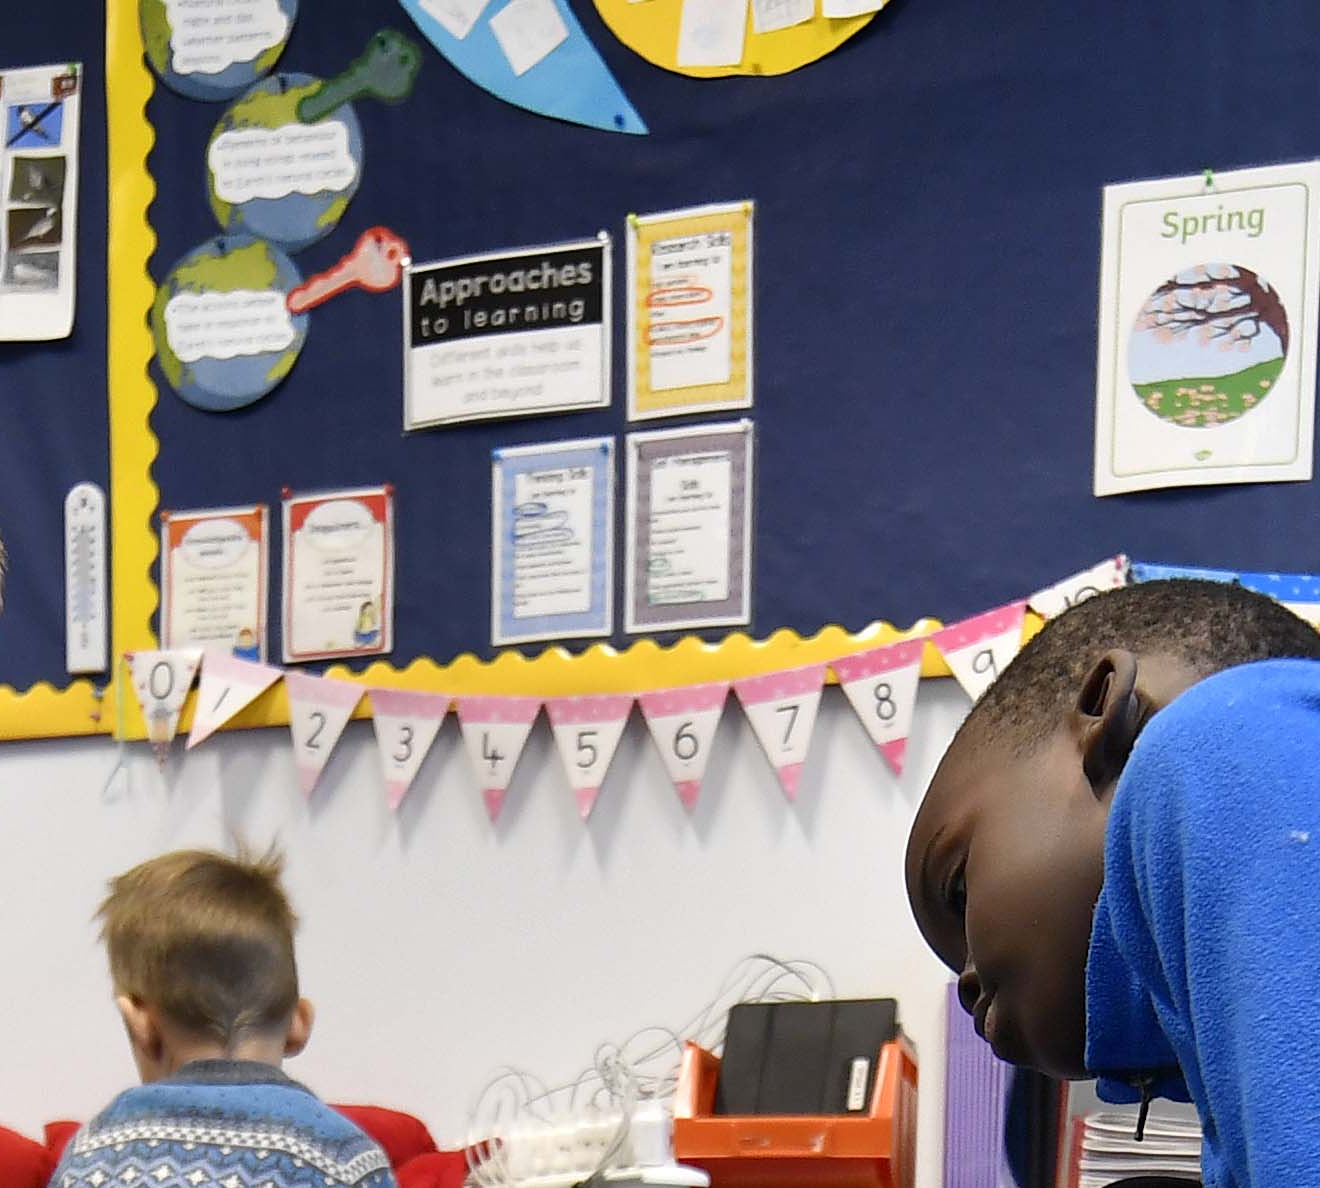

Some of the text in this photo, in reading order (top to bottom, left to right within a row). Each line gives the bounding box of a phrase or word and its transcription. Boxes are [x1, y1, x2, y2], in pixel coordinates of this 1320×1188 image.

[1160, 205, 1265, 245] Spring
[419, 260, 593, 308] Approaches
[421, 300, 585, 337] to learning
[148, 660, 174, 701] 0
[212, 687, 230, 714] 1
[874, 682, 897, 721] 8
[306, 711, 326, 750] 2
[392, 726, 414, 763] 3
[673, 721, 699, 761] 6
[776, 704, 799, 746] 7
[482, 731, 504, 769] 4
[577, 731, 599, 769] 5
